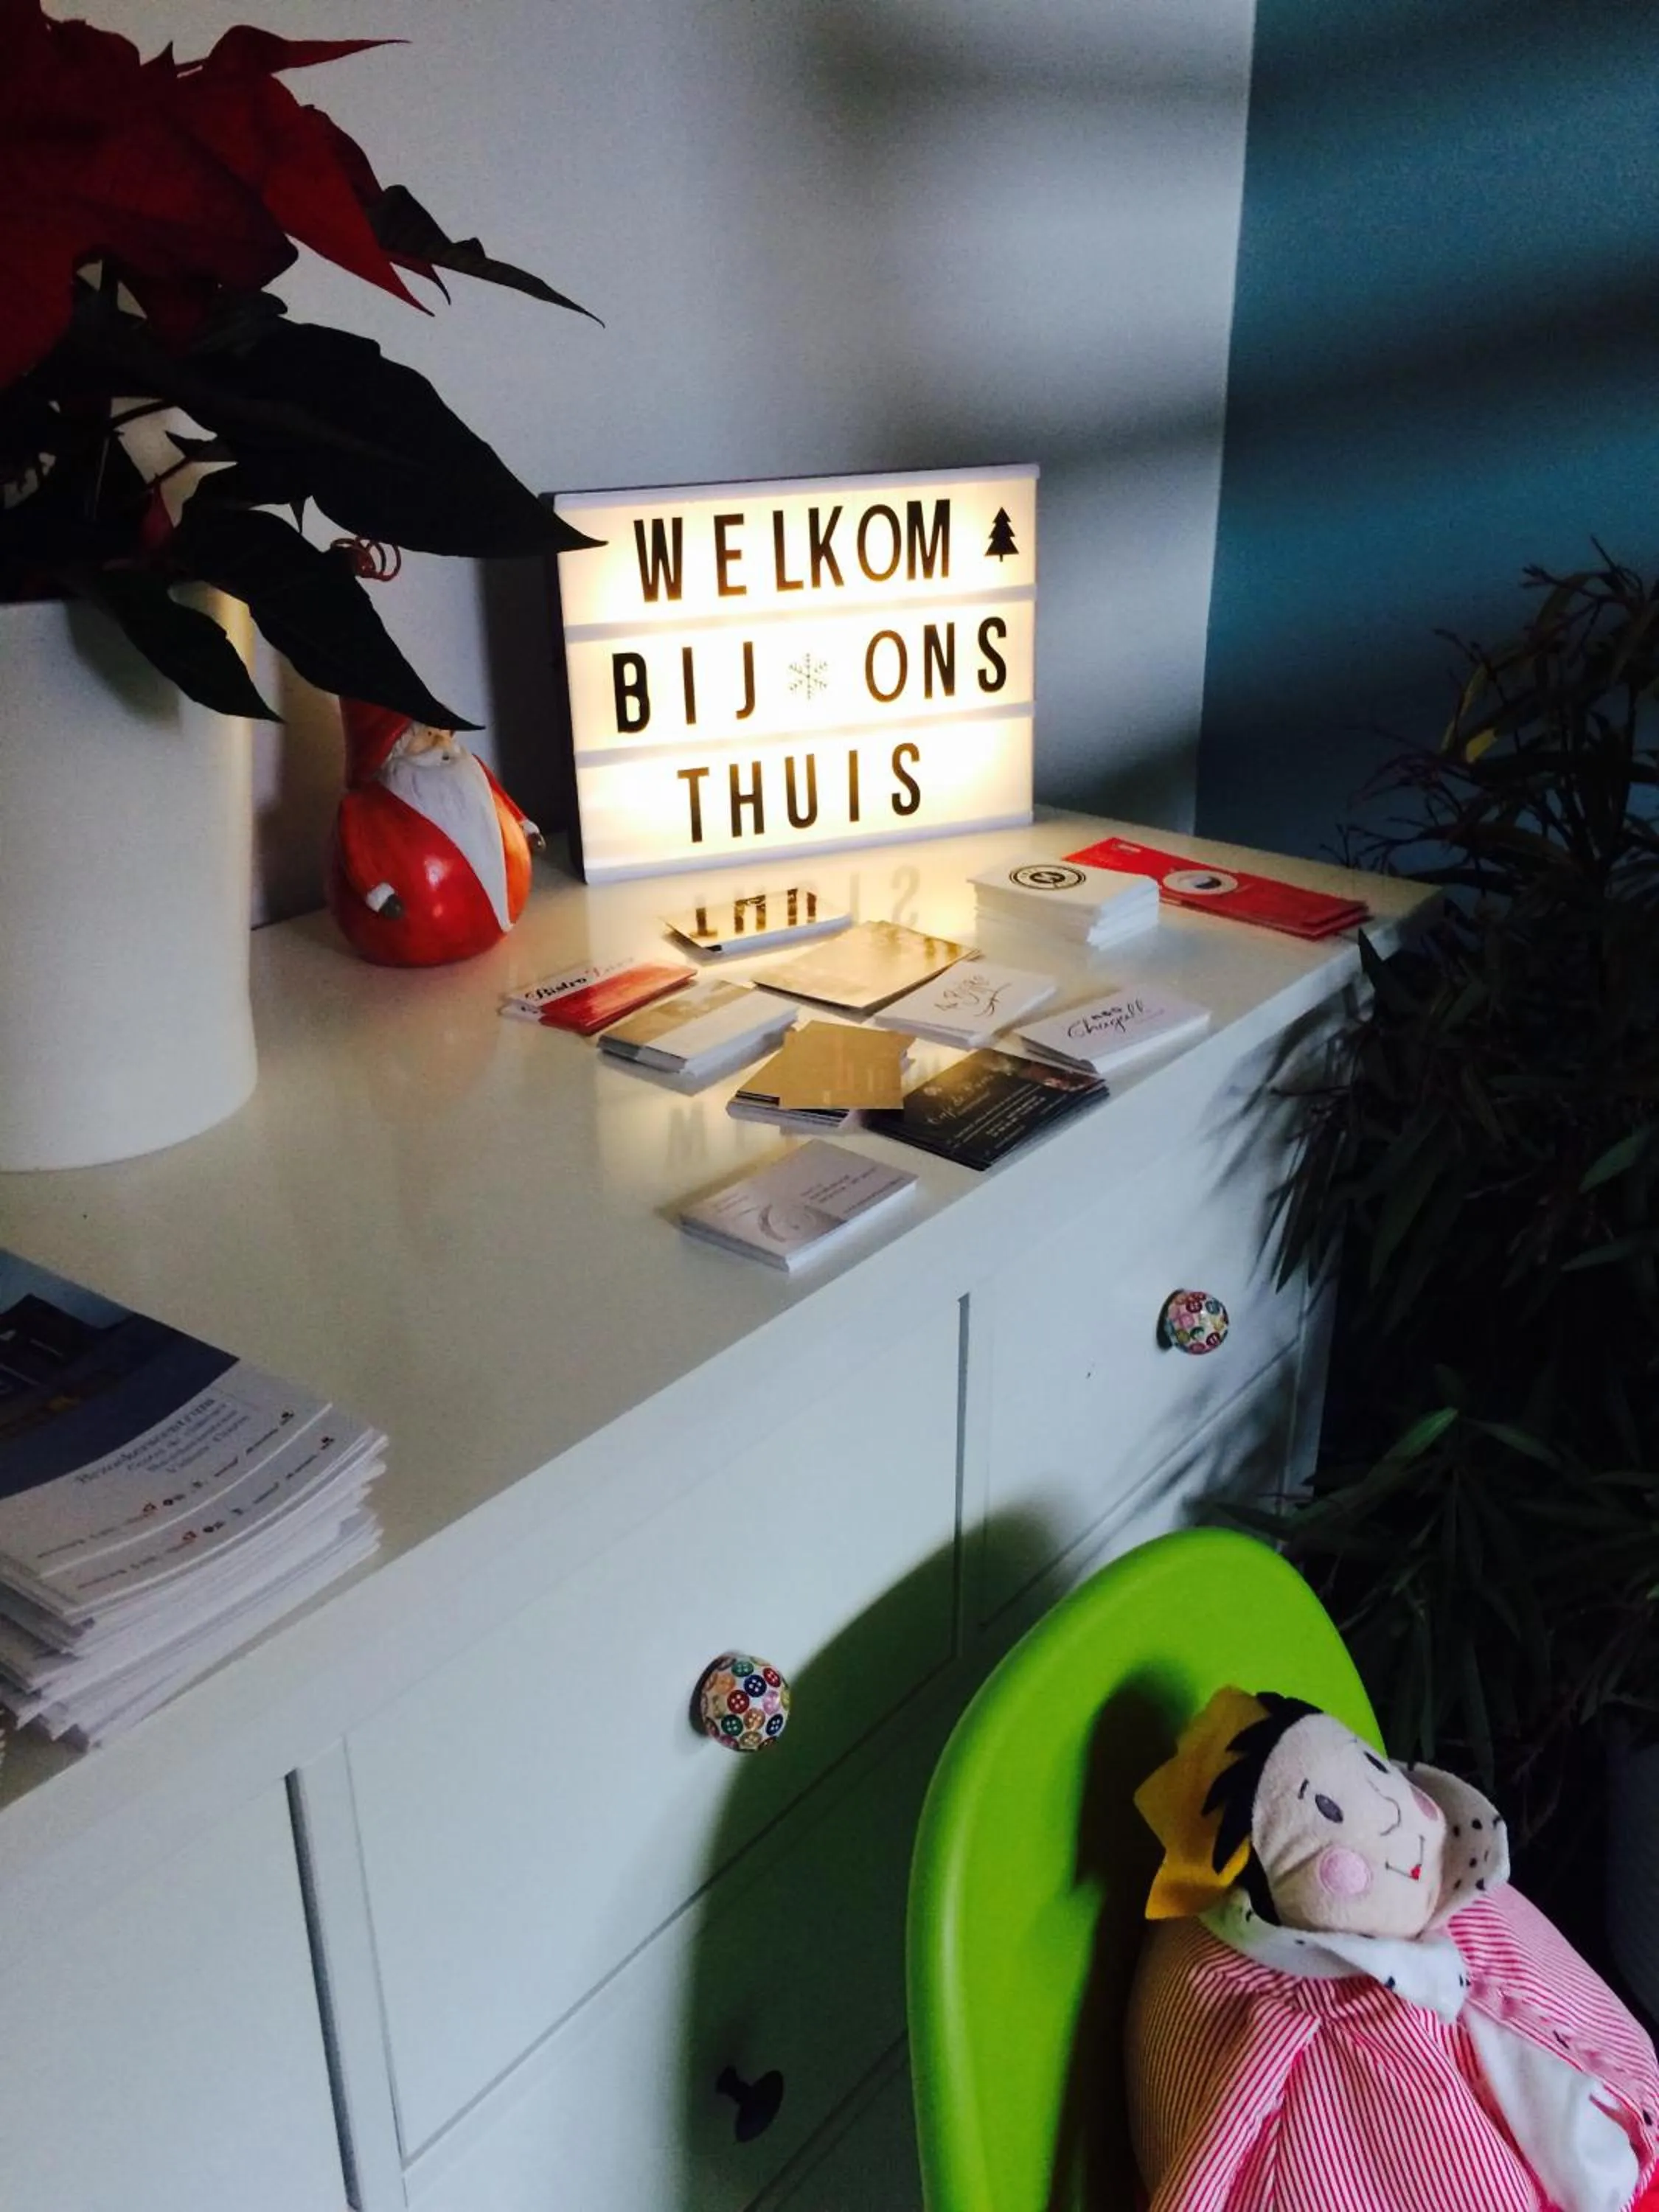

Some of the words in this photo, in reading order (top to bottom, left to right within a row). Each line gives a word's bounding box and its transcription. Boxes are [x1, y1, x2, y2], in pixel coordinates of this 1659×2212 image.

[634, 498, 950, 602] WELKOM
[612, 641, 756, 733] BIJ
[865, 617, 1007, 703] ONS
[677, 742, 921, 843] THUIS
